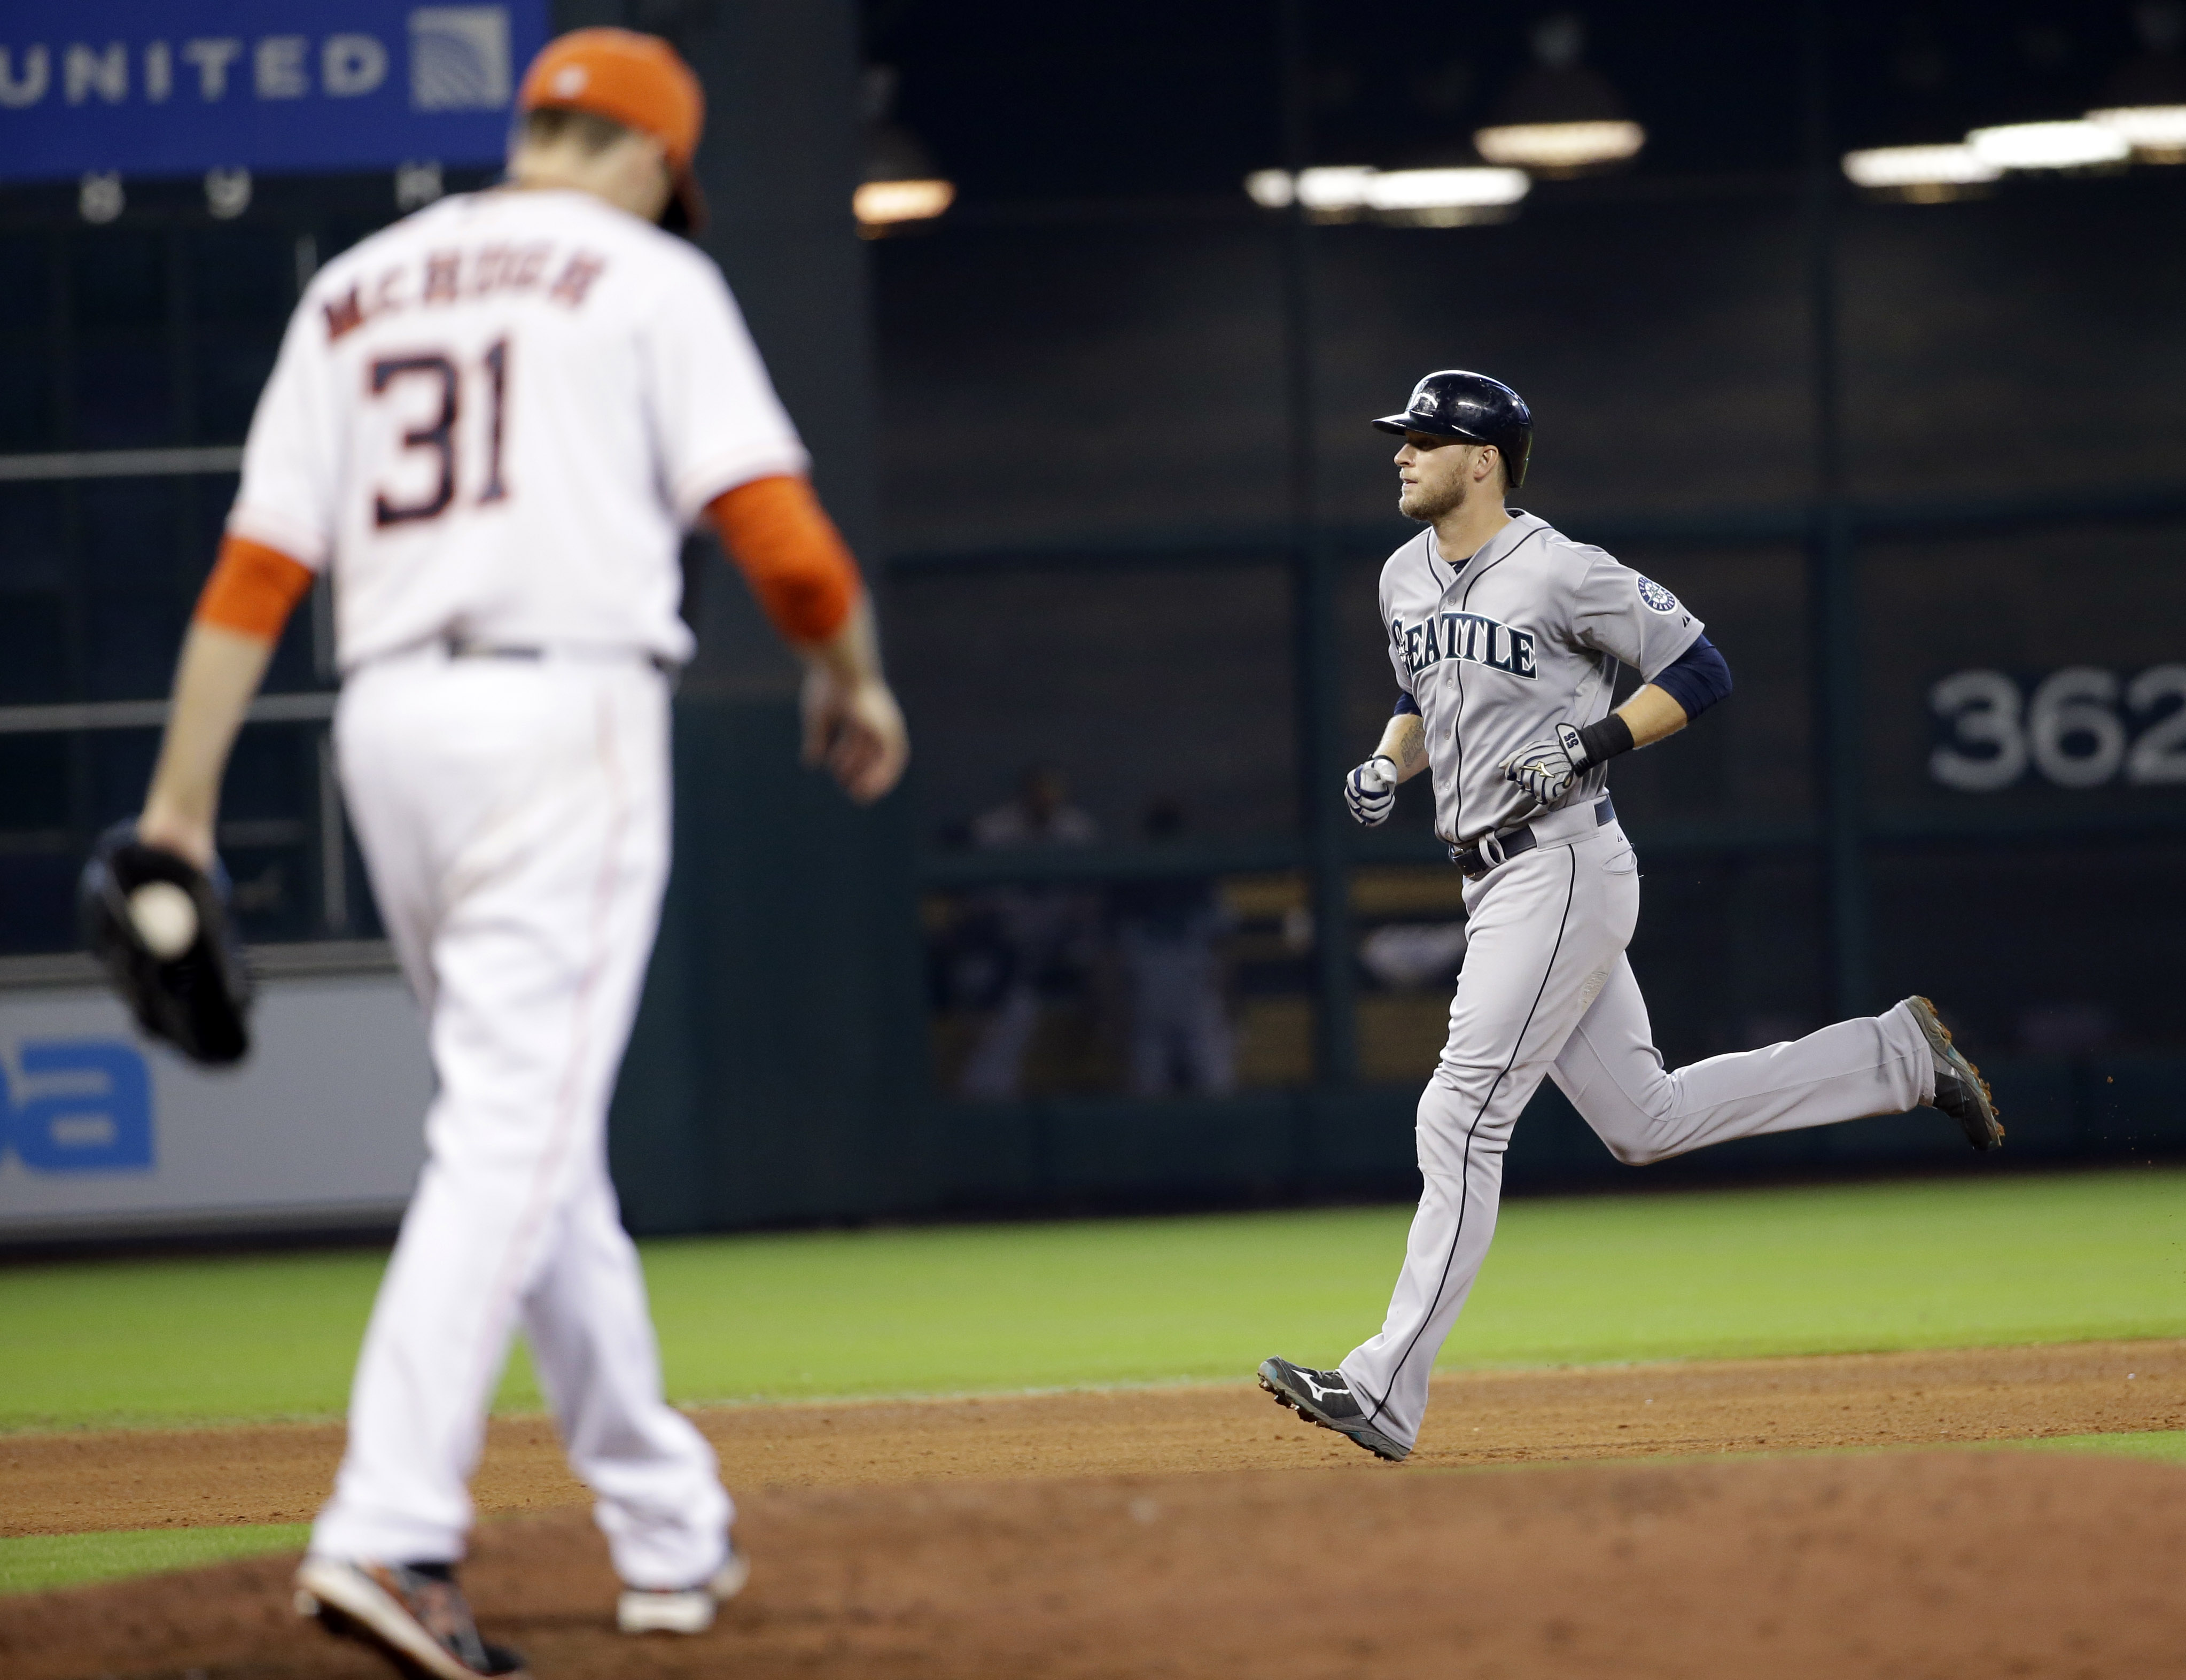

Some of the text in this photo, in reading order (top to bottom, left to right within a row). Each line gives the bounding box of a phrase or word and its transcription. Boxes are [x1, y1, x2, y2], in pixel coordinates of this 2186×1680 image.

[0, 32, 389, 107] UNITED
[366, 332, 509, 529] 31
[1391, 610, 1539, 681] SEATTLE
[1926, 664, 2186, 792] 362
